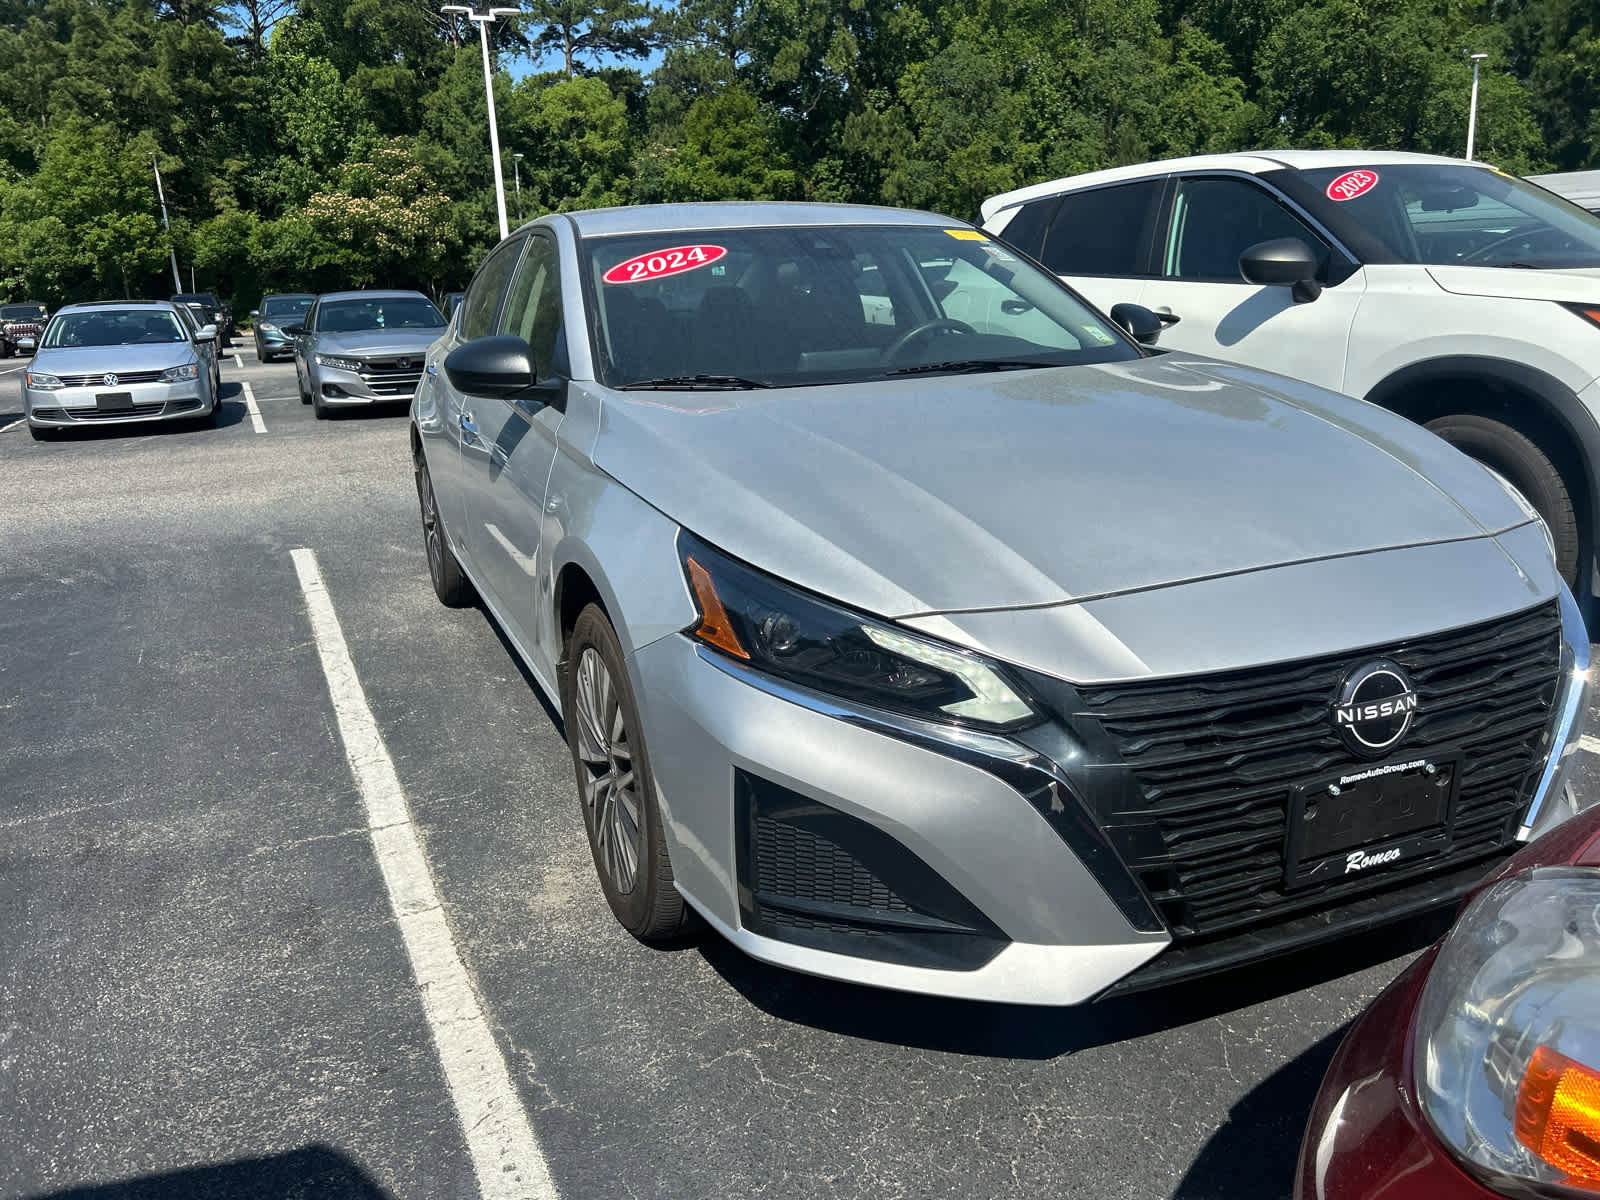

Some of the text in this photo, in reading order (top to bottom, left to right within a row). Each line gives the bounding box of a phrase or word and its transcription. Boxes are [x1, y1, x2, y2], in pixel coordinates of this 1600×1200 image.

[1335, 172, 1371, 198] 2023
[628, 247, 707, 280] 2024
[1337, 694, 1416, 723] NISSAN
[1340, 760, 1425, 785] RomeoAutoGroup.com
[1345, 848, 1401, 874] Romeo
